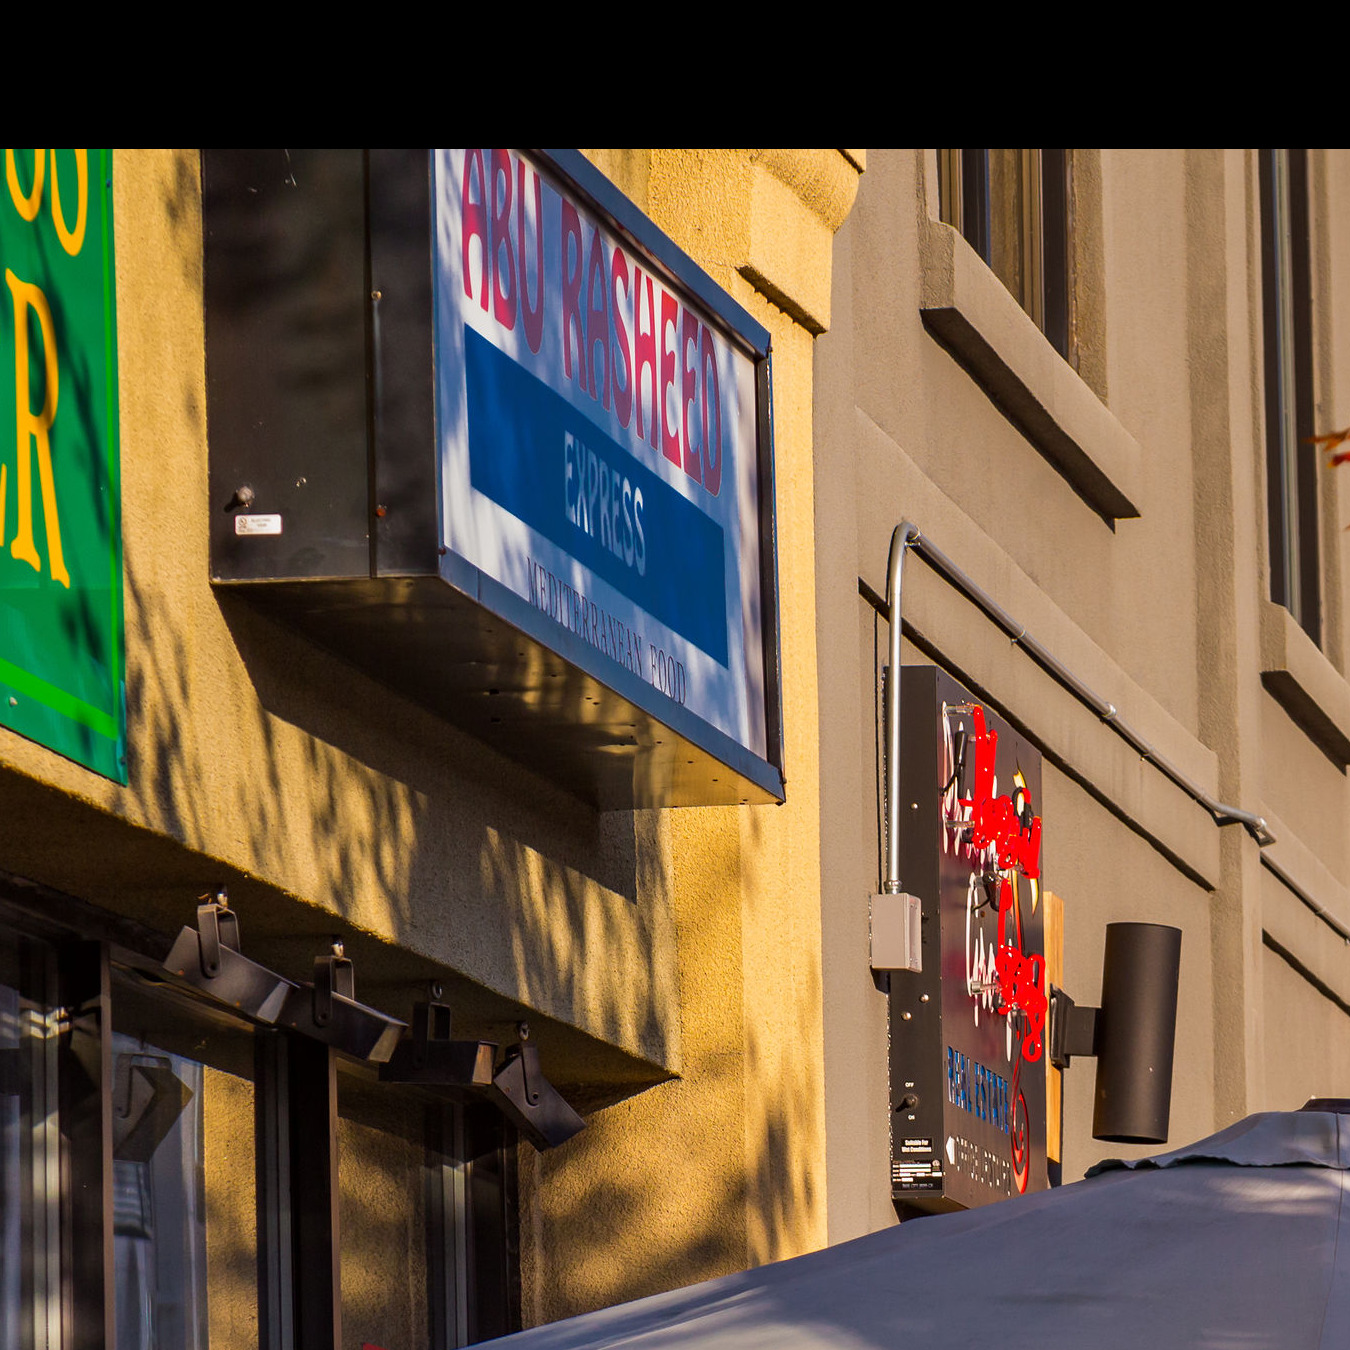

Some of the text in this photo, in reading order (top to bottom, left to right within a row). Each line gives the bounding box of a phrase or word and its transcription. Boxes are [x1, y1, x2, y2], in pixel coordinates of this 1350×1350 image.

[462, 149, 721, 497] ABU RASHEED
[565, 430, 646, 577] EXPRESS
[527, 557, 687, 706] MEDITERRANEAN FOOD
[947, 1045, 1009, 1134] REAL ESTATE
